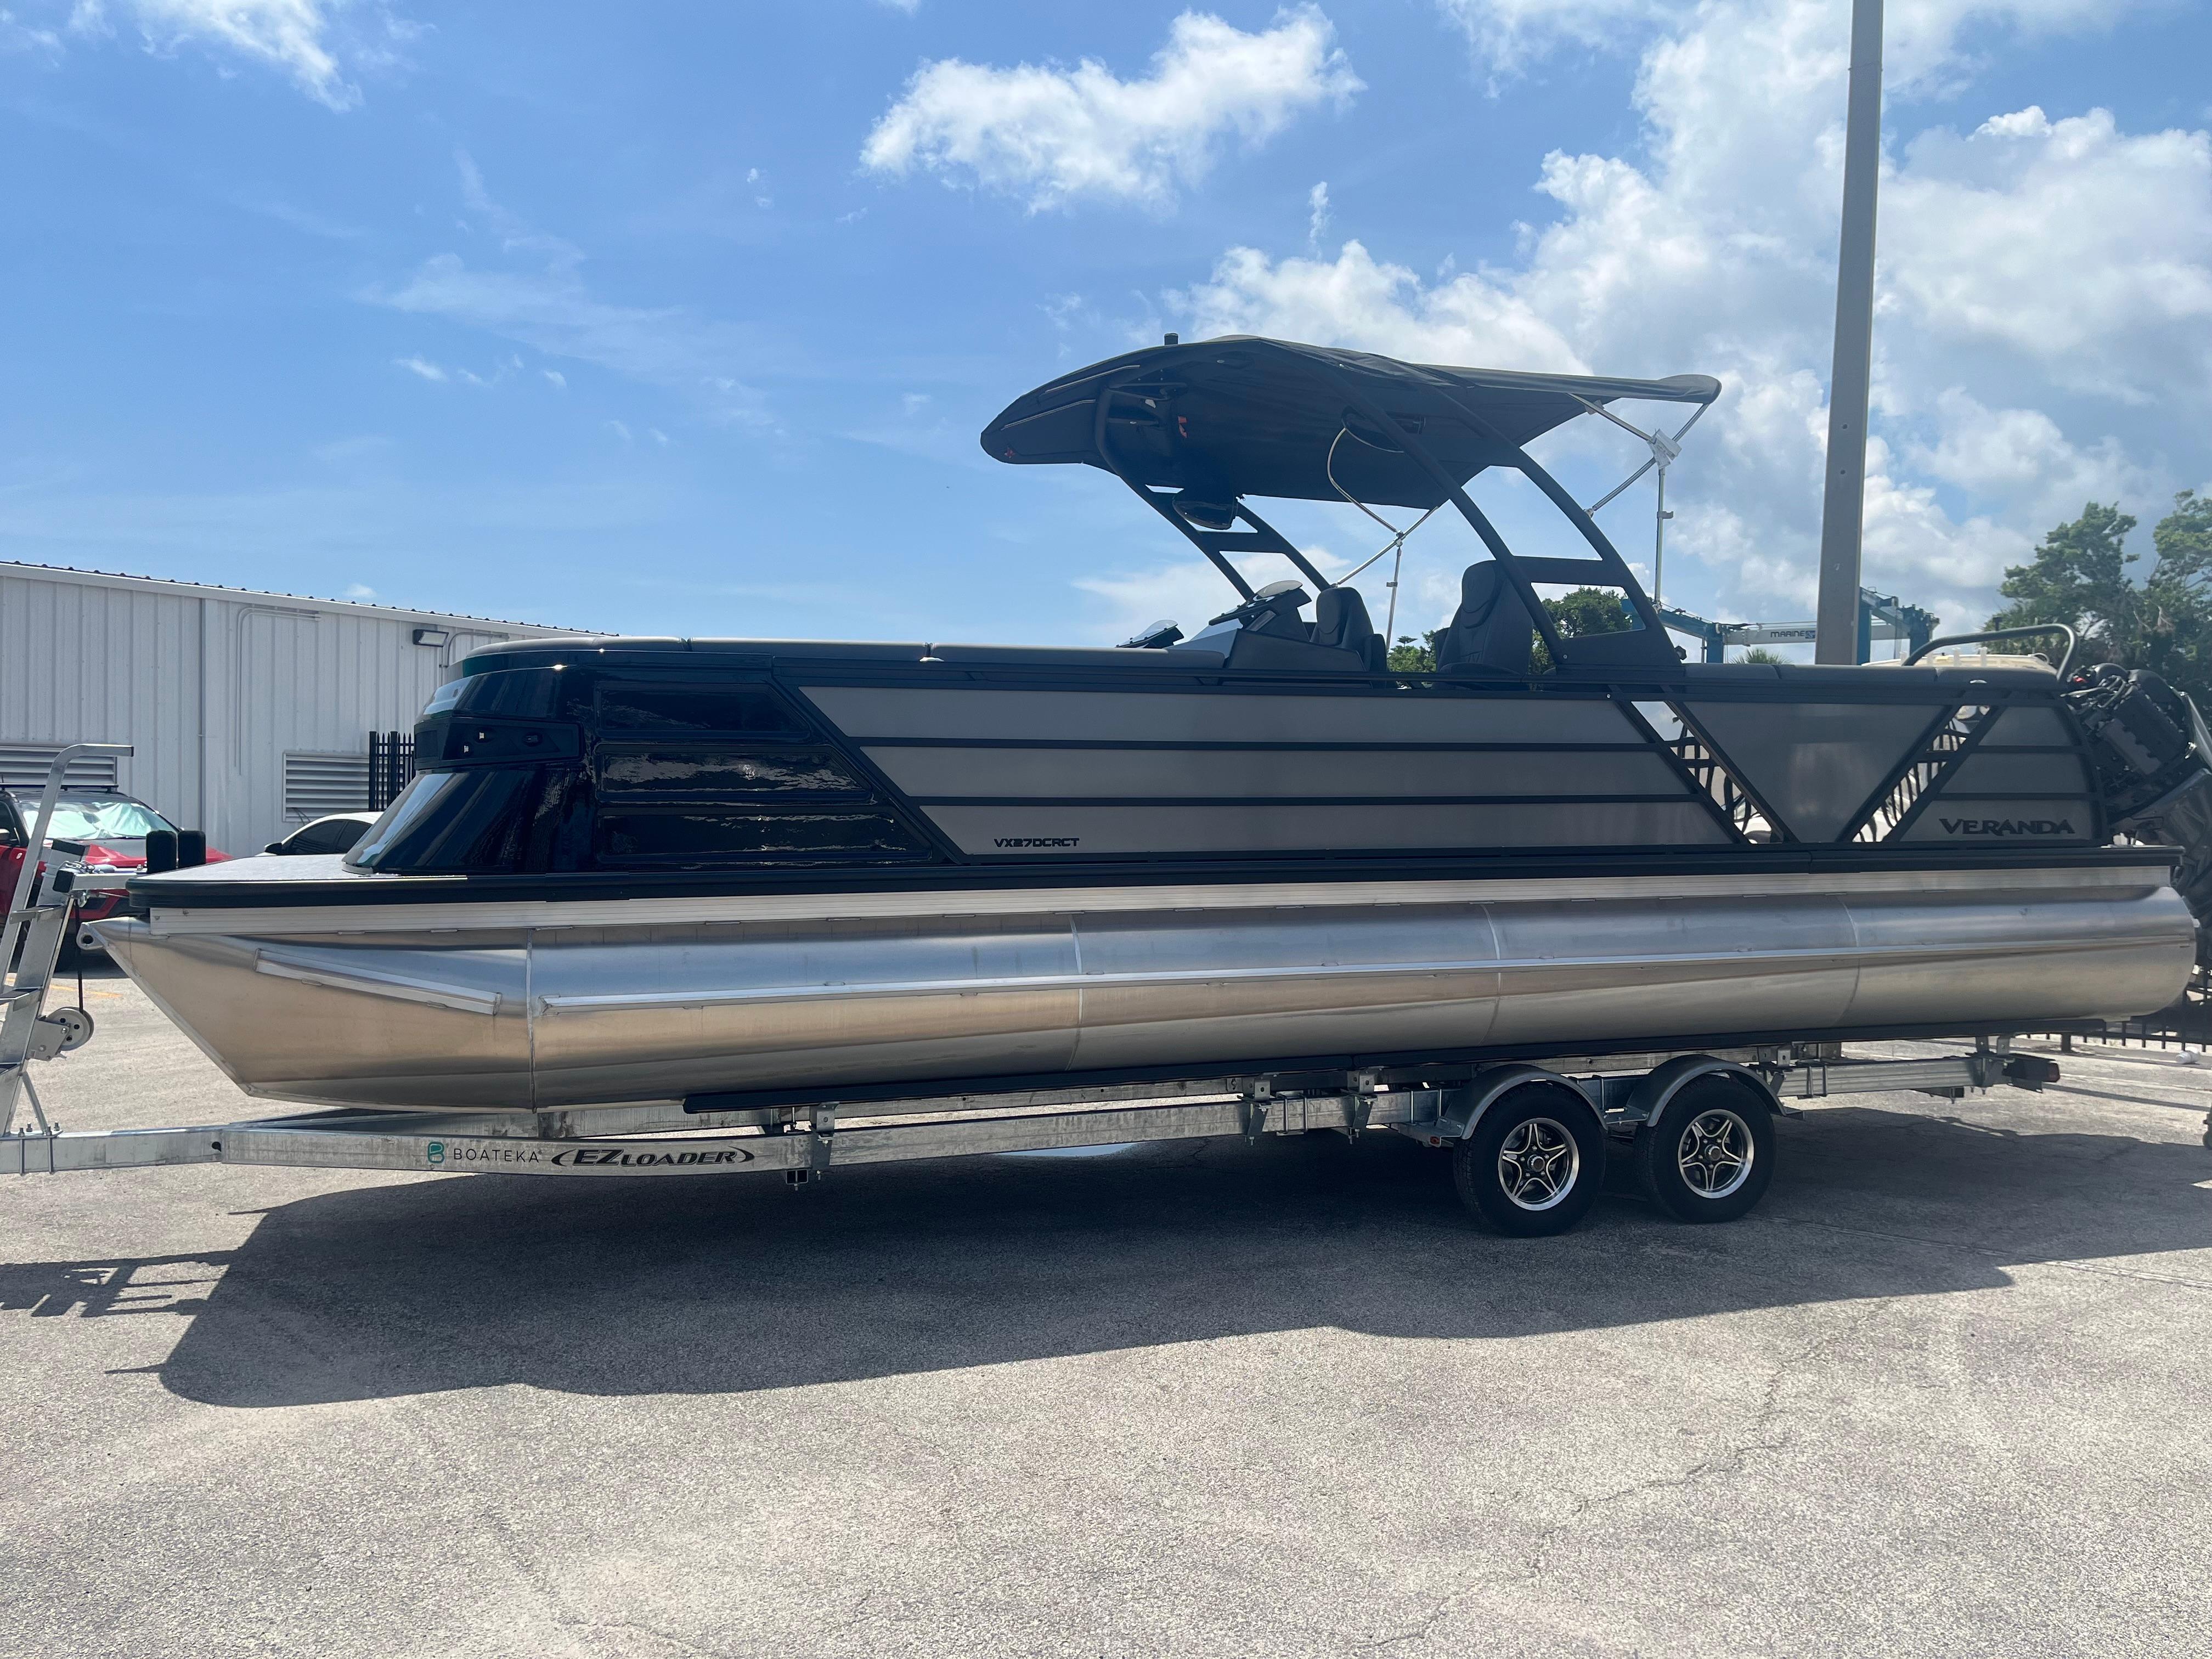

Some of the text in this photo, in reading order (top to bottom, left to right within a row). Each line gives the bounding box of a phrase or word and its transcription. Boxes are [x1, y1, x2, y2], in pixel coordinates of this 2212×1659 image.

[1939, 818, 2075, 836] VERANDA
[994, 838, 1080, 848] VX27DCRCT
[453, 1148, 539, 1163] BOATEKA
